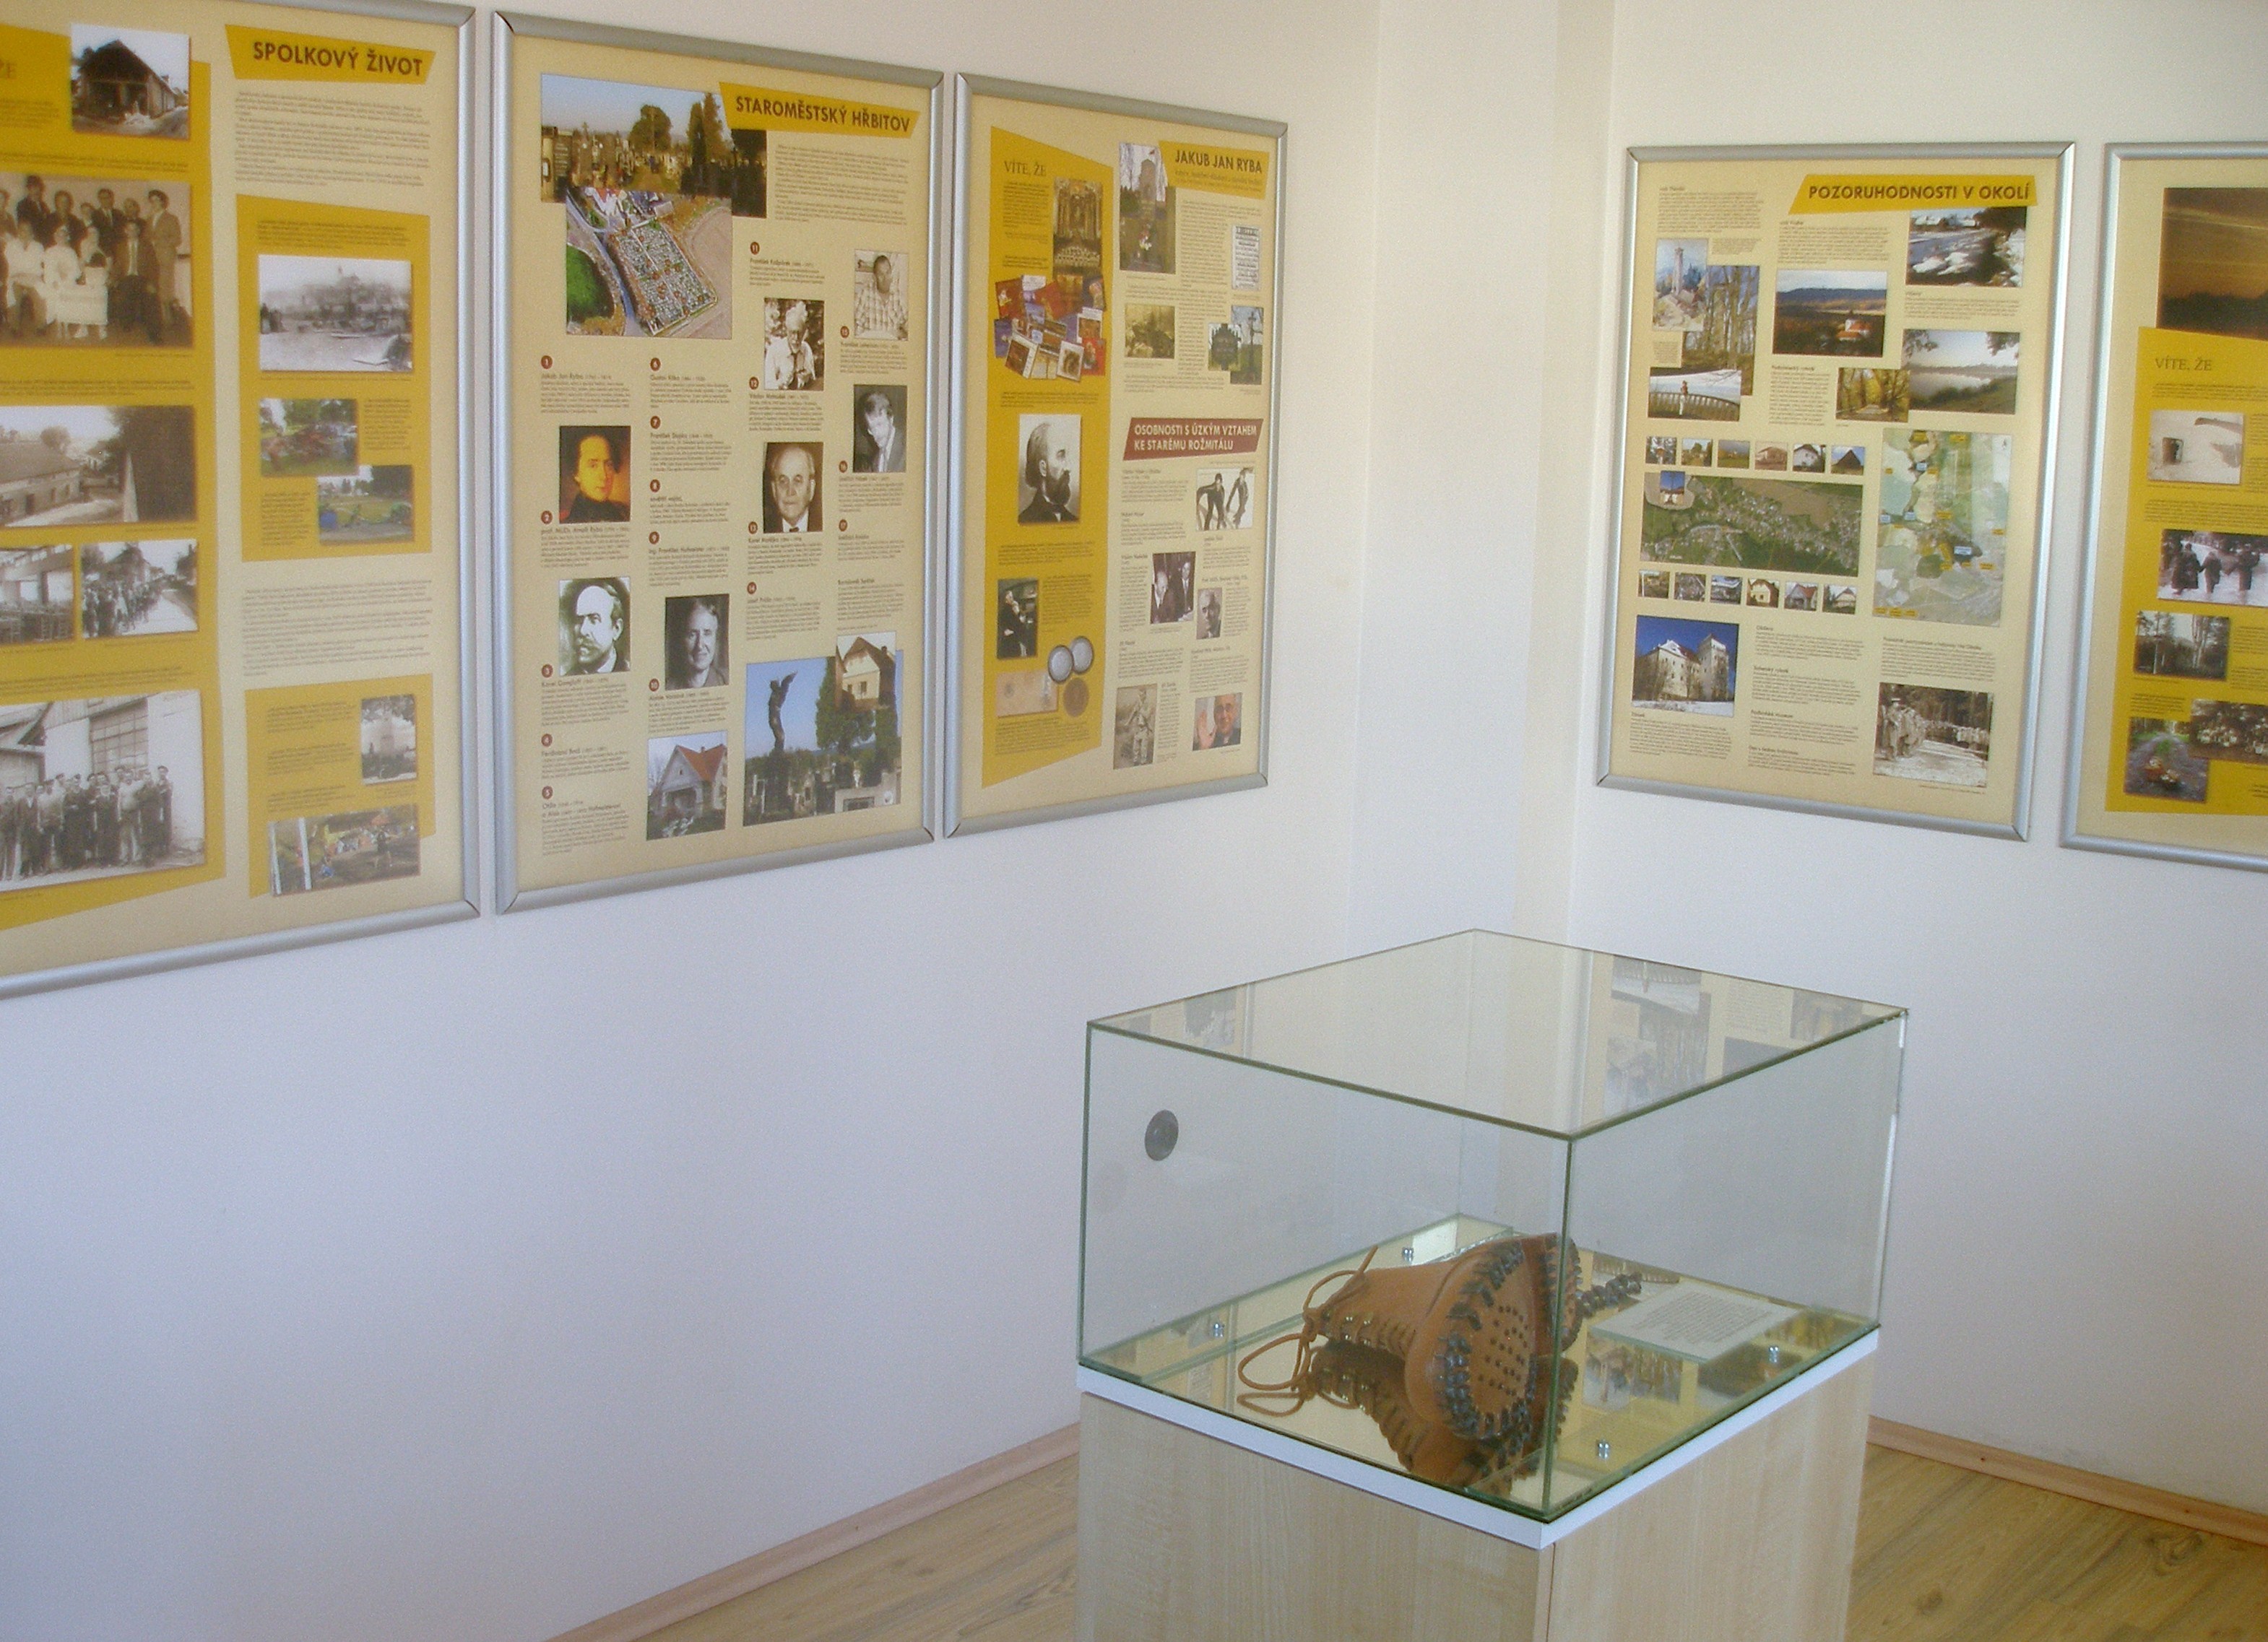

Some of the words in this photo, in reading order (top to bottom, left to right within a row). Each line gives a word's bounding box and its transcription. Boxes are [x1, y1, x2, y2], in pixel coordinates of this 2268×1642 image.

[253, 41, 360, 70] SPOLKOVÝ
[366, 48, 424, 77] ŽIVOT
[736, 95, 847, 126] STAROMĚSTSKÝ
[852, 108, 911, 133] HŘBITOV
[1034, 161, 1047, 177] ŽE
[1174, 149, 1211, 167] JAKUB
[1212, 155, 1234, 170] JAN
[1237, 157, 1263, 174] RYBA
[1809, 185, 1957, 199] POZORUHODNOSTI
[1962, 186, 1974, 199] V
[1978, 182, 2030, 199] OKOLÍ
[2194, 356, 2212, 372] ŽE
[1134, 424, 1183, 436] OSOBNOSTI
[1185, 425, 1190, 436] S
[1192, 422, 1220, 436] ÚZKÝM
[1222, 425, 1258, 436] VZTAHEM
[1133, 440, 1146, 451] KE
[1147, 438, 1186, 451] STARÉMU
[1188, 437, 1234, 451] ROŽMITÁLU
